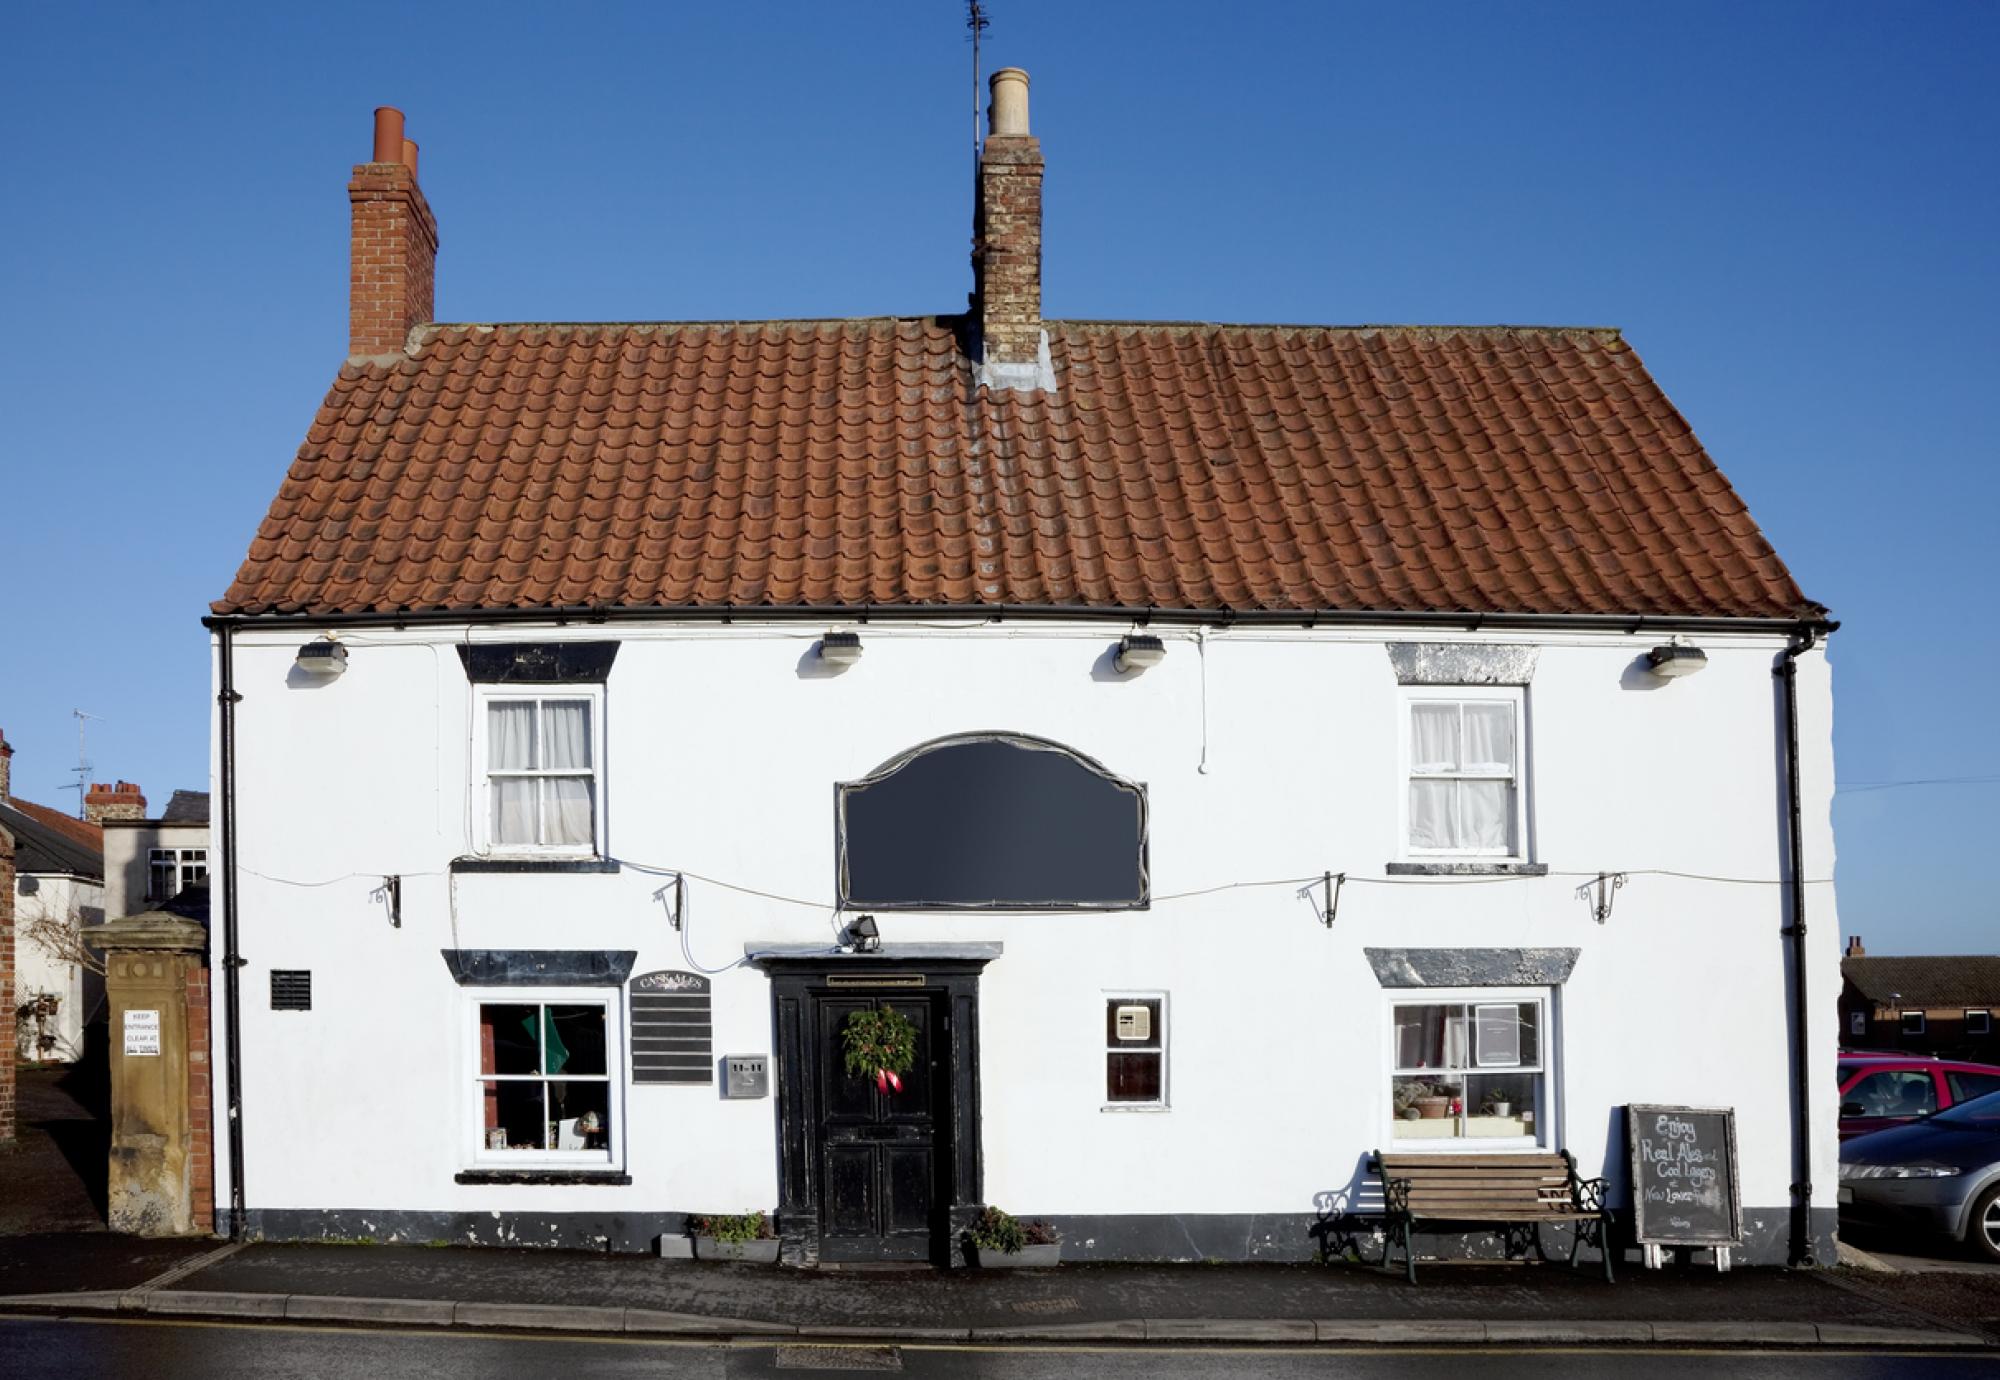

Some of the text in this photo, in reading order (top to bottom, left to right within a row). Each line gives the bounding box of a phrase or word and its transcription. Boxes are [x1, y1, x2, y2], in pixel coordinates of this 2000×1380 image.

[1656, 1115, 1696, 1142] Enjoy
[1641, 1139, 1674, 1162] Real
[1676, 1142, 1703, 1162] Ales
